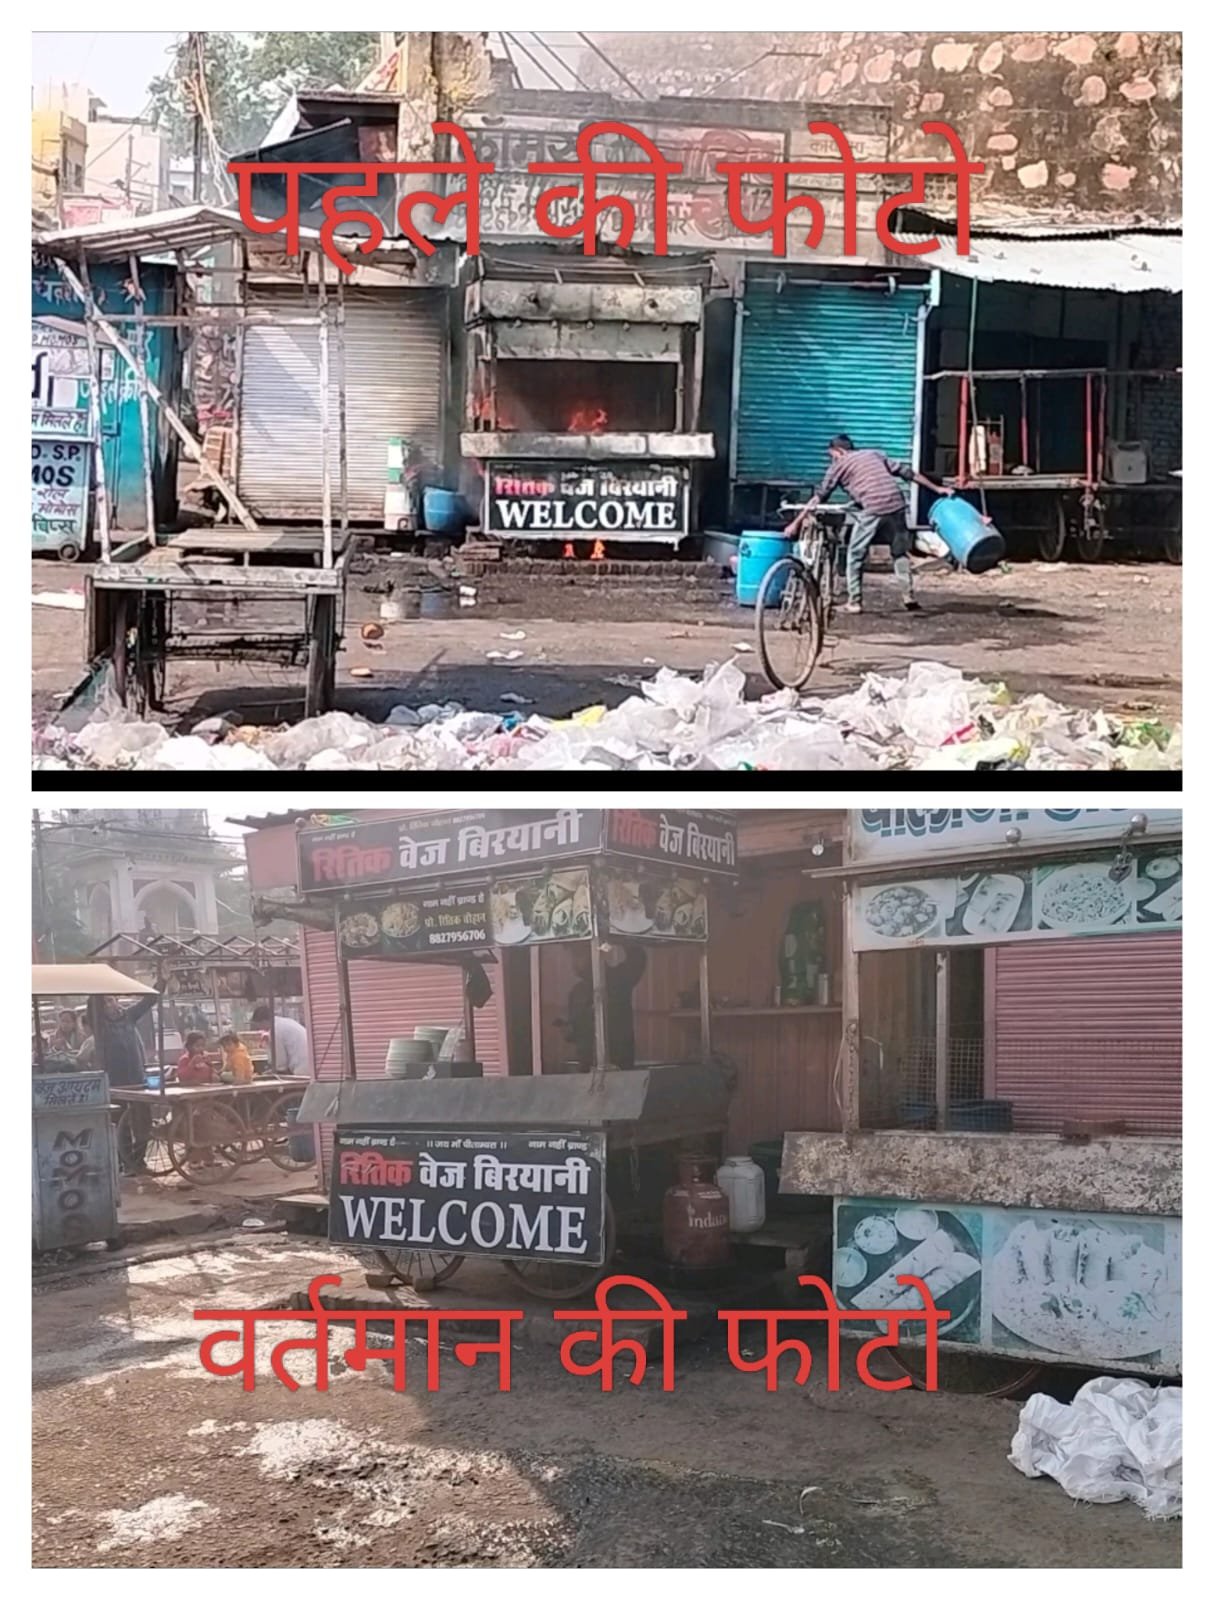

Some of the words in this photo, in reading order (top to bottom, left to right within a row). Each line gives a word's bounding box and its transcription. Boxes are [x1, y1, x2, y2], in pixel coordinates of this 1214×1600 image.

[495, 500, 677, 529] WELCOME
[399, 836, 451, 870] वेज
[458, 809, 583, 862] बिरयानी
[659, 813, 685, 855] वेज
[687, 822, 736, 866] बिरयानी
[429, 930, 486, 945] 8827956706
[339, 1151, 413, 1187] रितिक
[418, 1151, 468, 1189] वेज
[474, 1151, 591, 1195] बिरयानी
[339, 1194, 588, 1255] WELCOME
